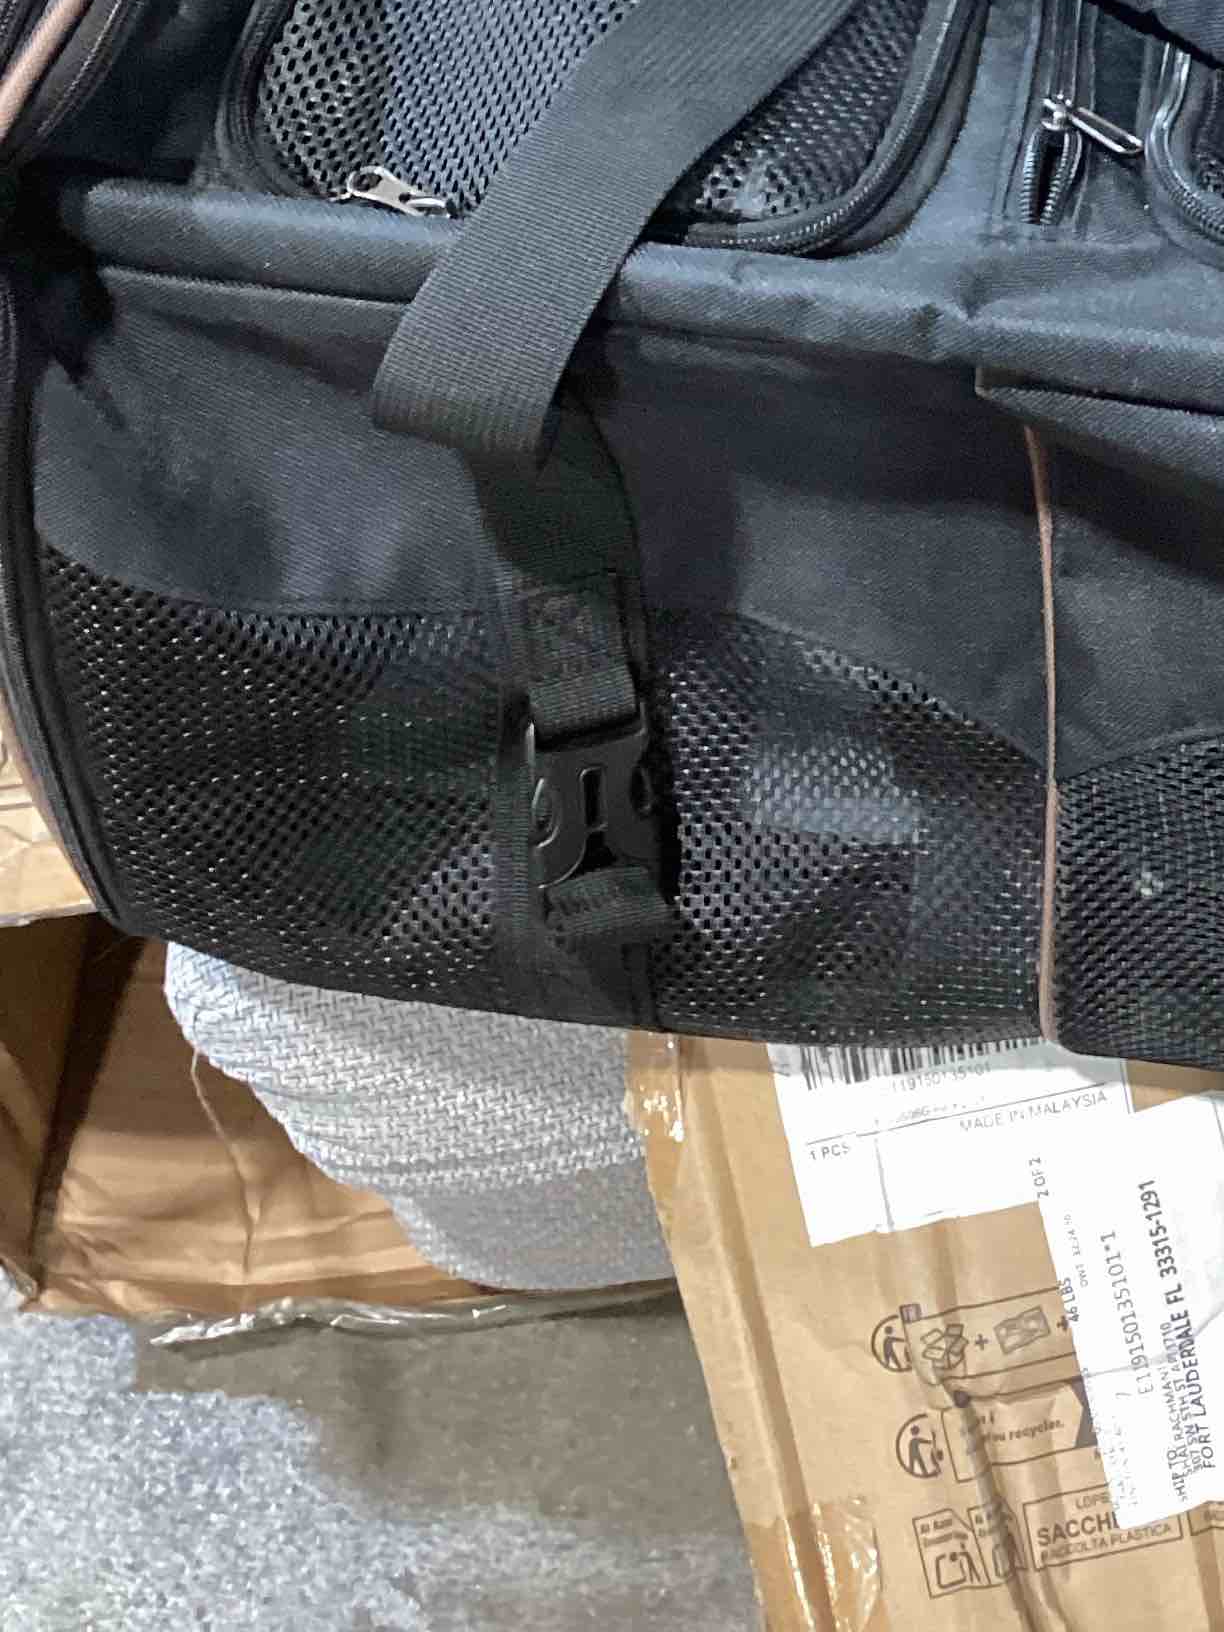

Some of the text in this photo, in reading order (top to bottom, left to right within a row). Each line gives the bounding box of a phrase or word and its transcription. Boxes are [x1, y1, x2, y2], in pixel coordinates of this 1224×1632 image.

[821, 1143, 851, 1159] PCS
[1137, 1179, 1216, 1470] FORT LAUDERDALE FL 33315-1291
